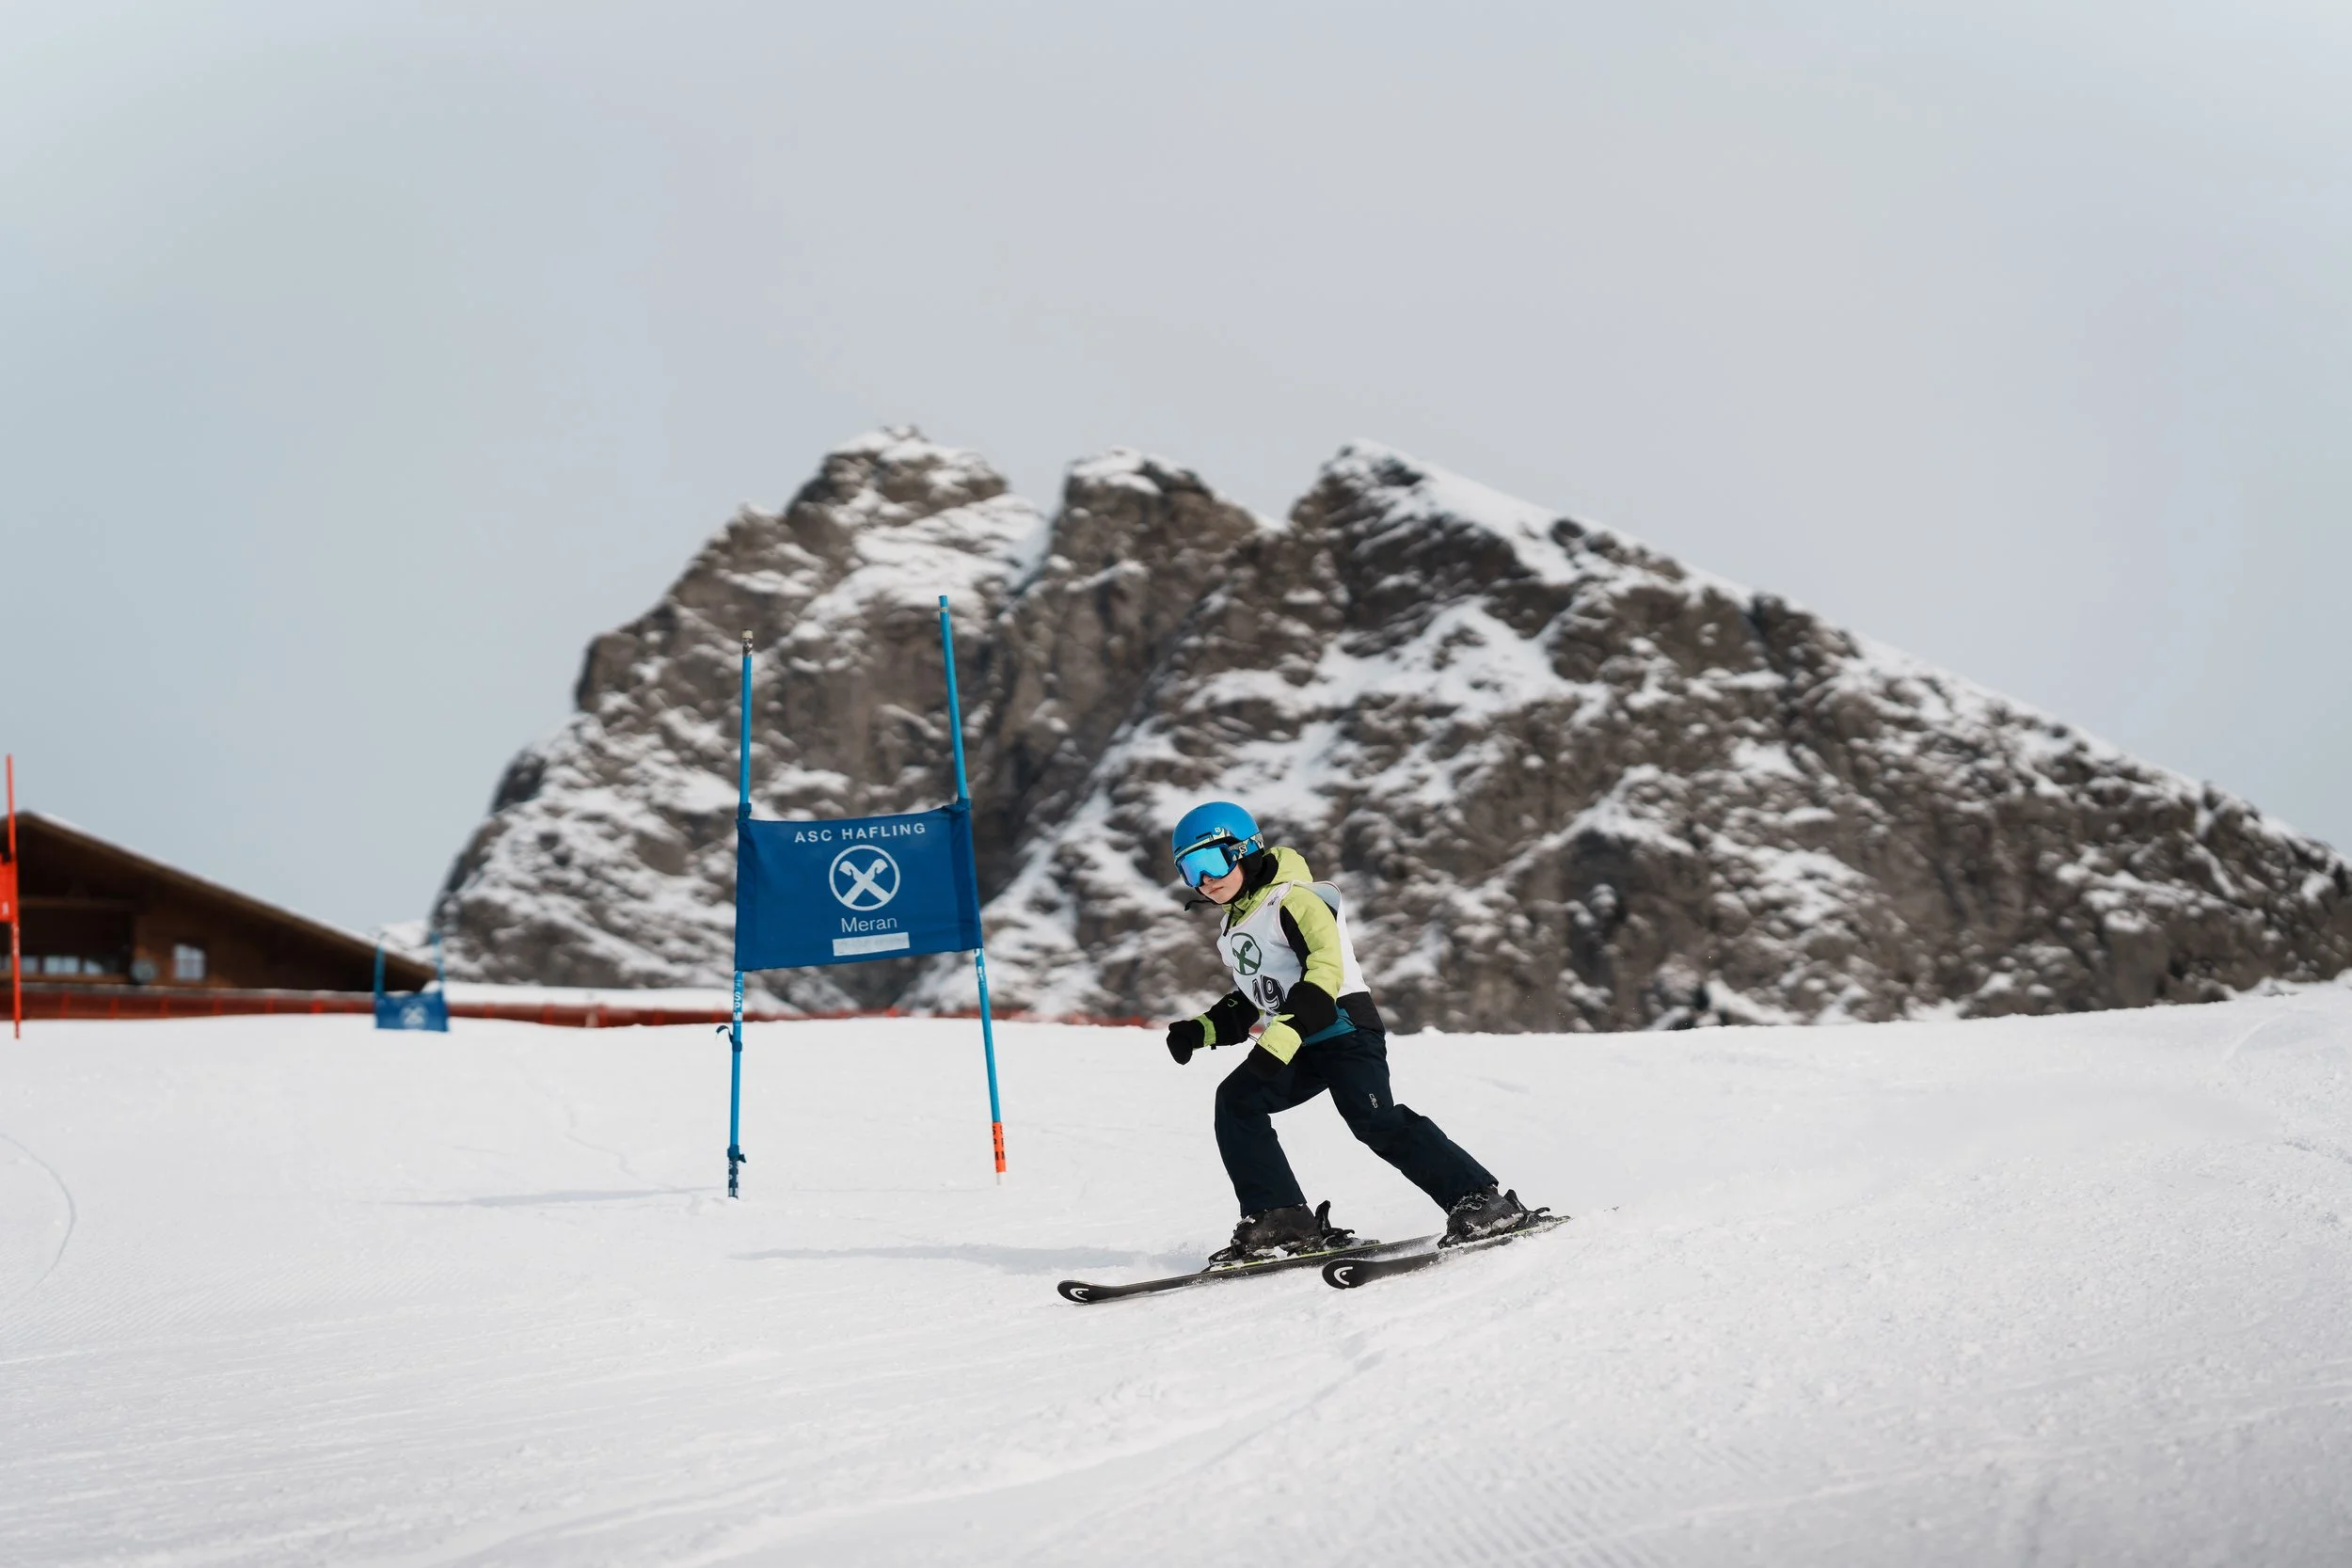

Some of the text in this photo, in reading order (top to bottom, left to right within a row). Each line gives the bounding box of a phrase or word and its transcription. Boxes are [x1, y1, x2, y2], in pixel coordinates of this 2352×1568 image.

[794, 822, 926, 843] ASC HAFLING
[840, 916, 898, 933] Meran
[1252, 974, 1286, 1011] 19
